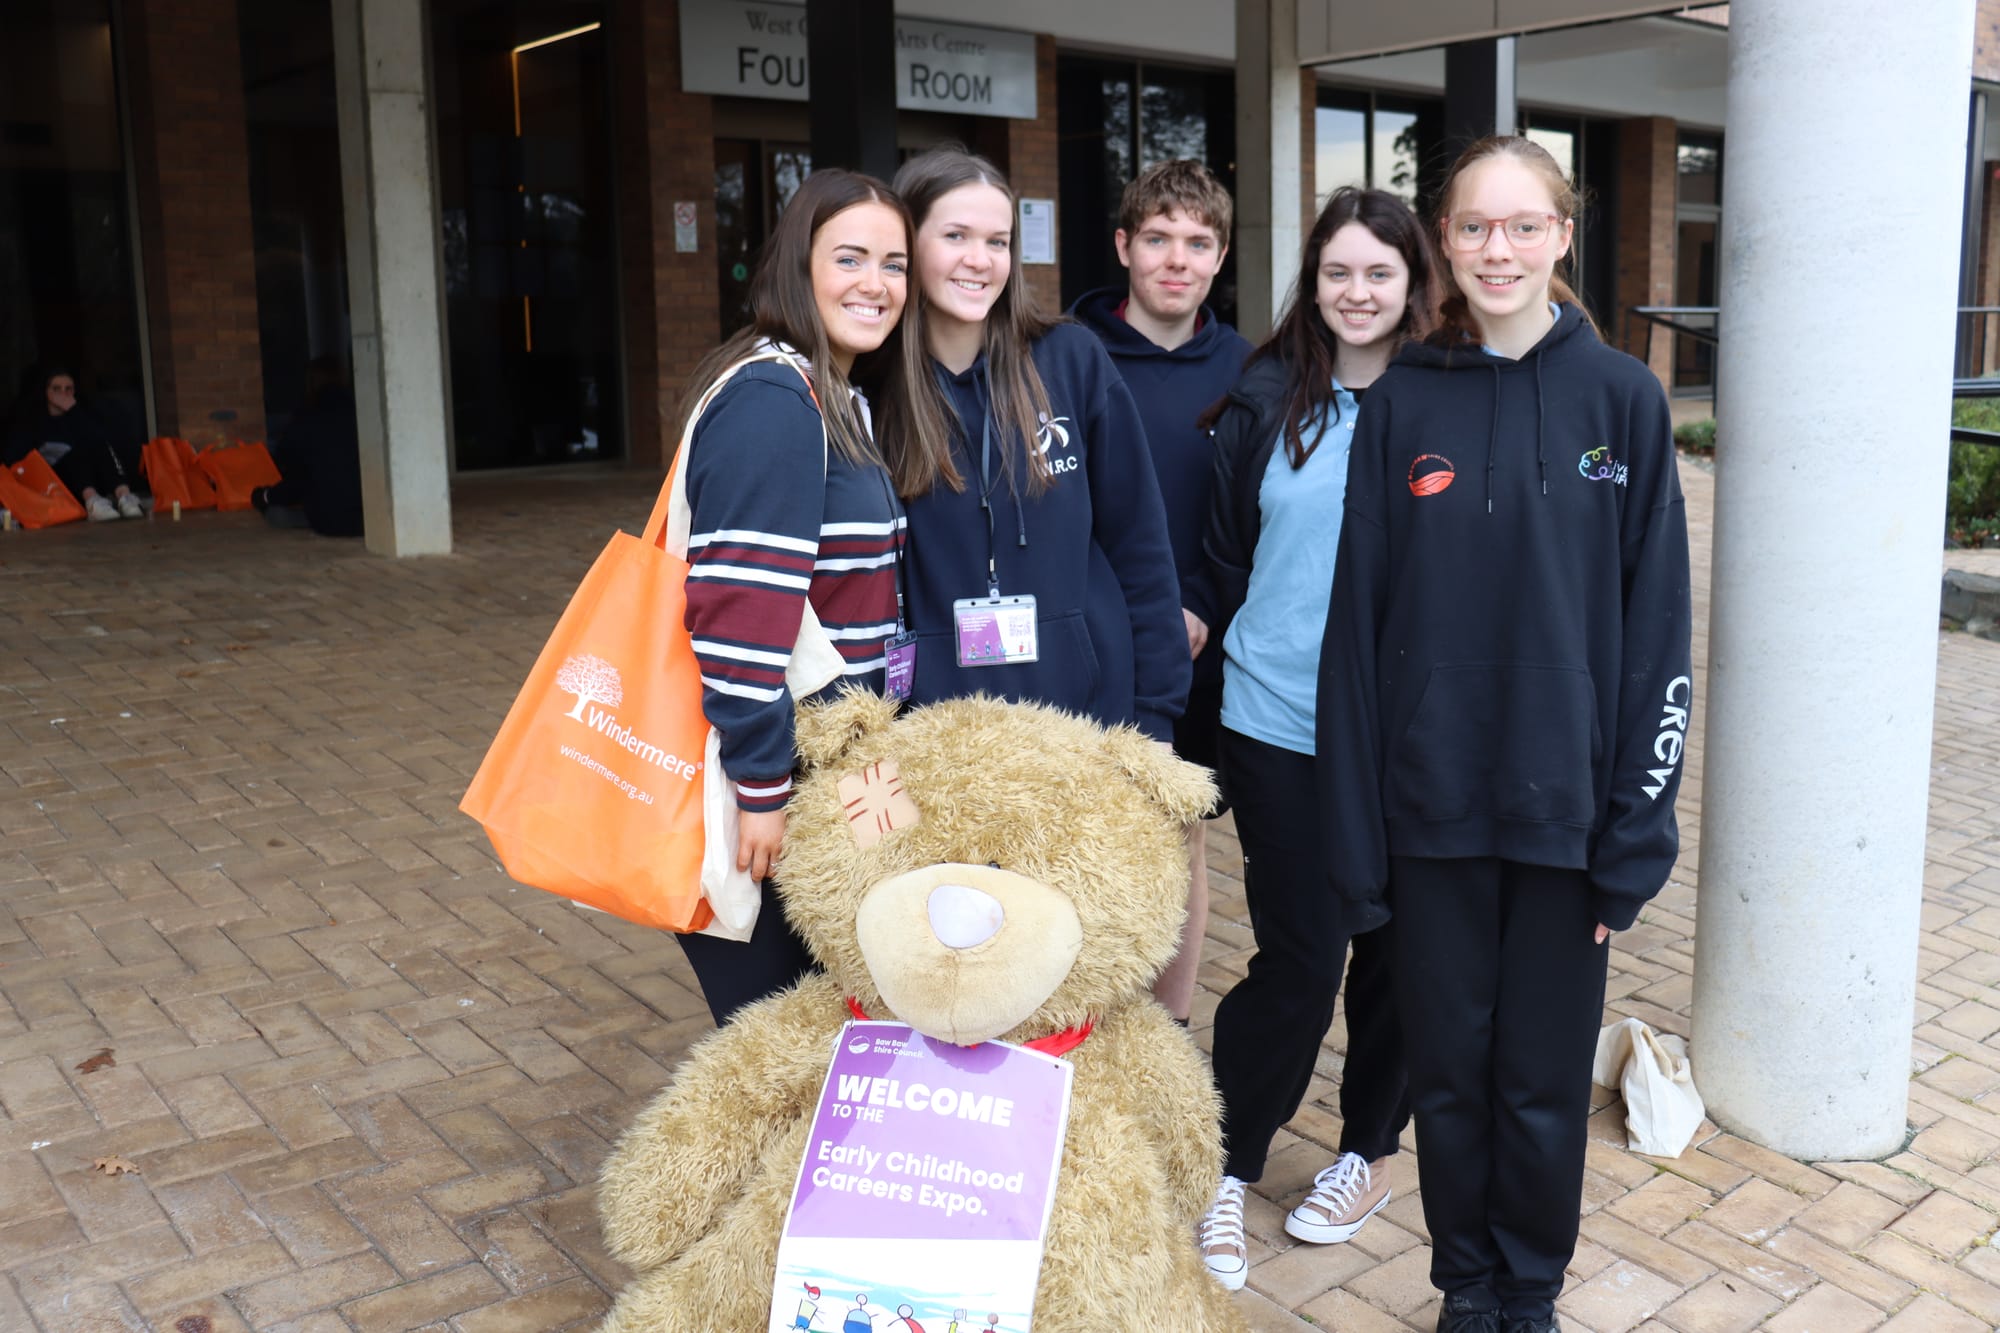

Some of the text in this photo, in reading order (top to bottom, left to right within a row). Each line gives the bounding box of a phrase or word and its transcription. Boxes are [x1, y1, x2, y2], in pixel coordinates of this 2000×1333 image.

[745, 10, 793, 35] West
[932, 32, 986, 56] Centre
[910, 63, 992, 104] ROOM
[587, 706, 697, 782] Windermere
[560, 745, 655, 805] windermere.org.au
[873, 1046, 892, 1054] Shire
[875, 1038, 908, 1047] Baw Baw
[832, 1104, 885, 1123] TO THE
[837, 1074, 1014, 1127] WELCOME
[818, 1140, 1024, 1194] Early Childhood
[812, 1167, 988, 1217] Careers Expo.
